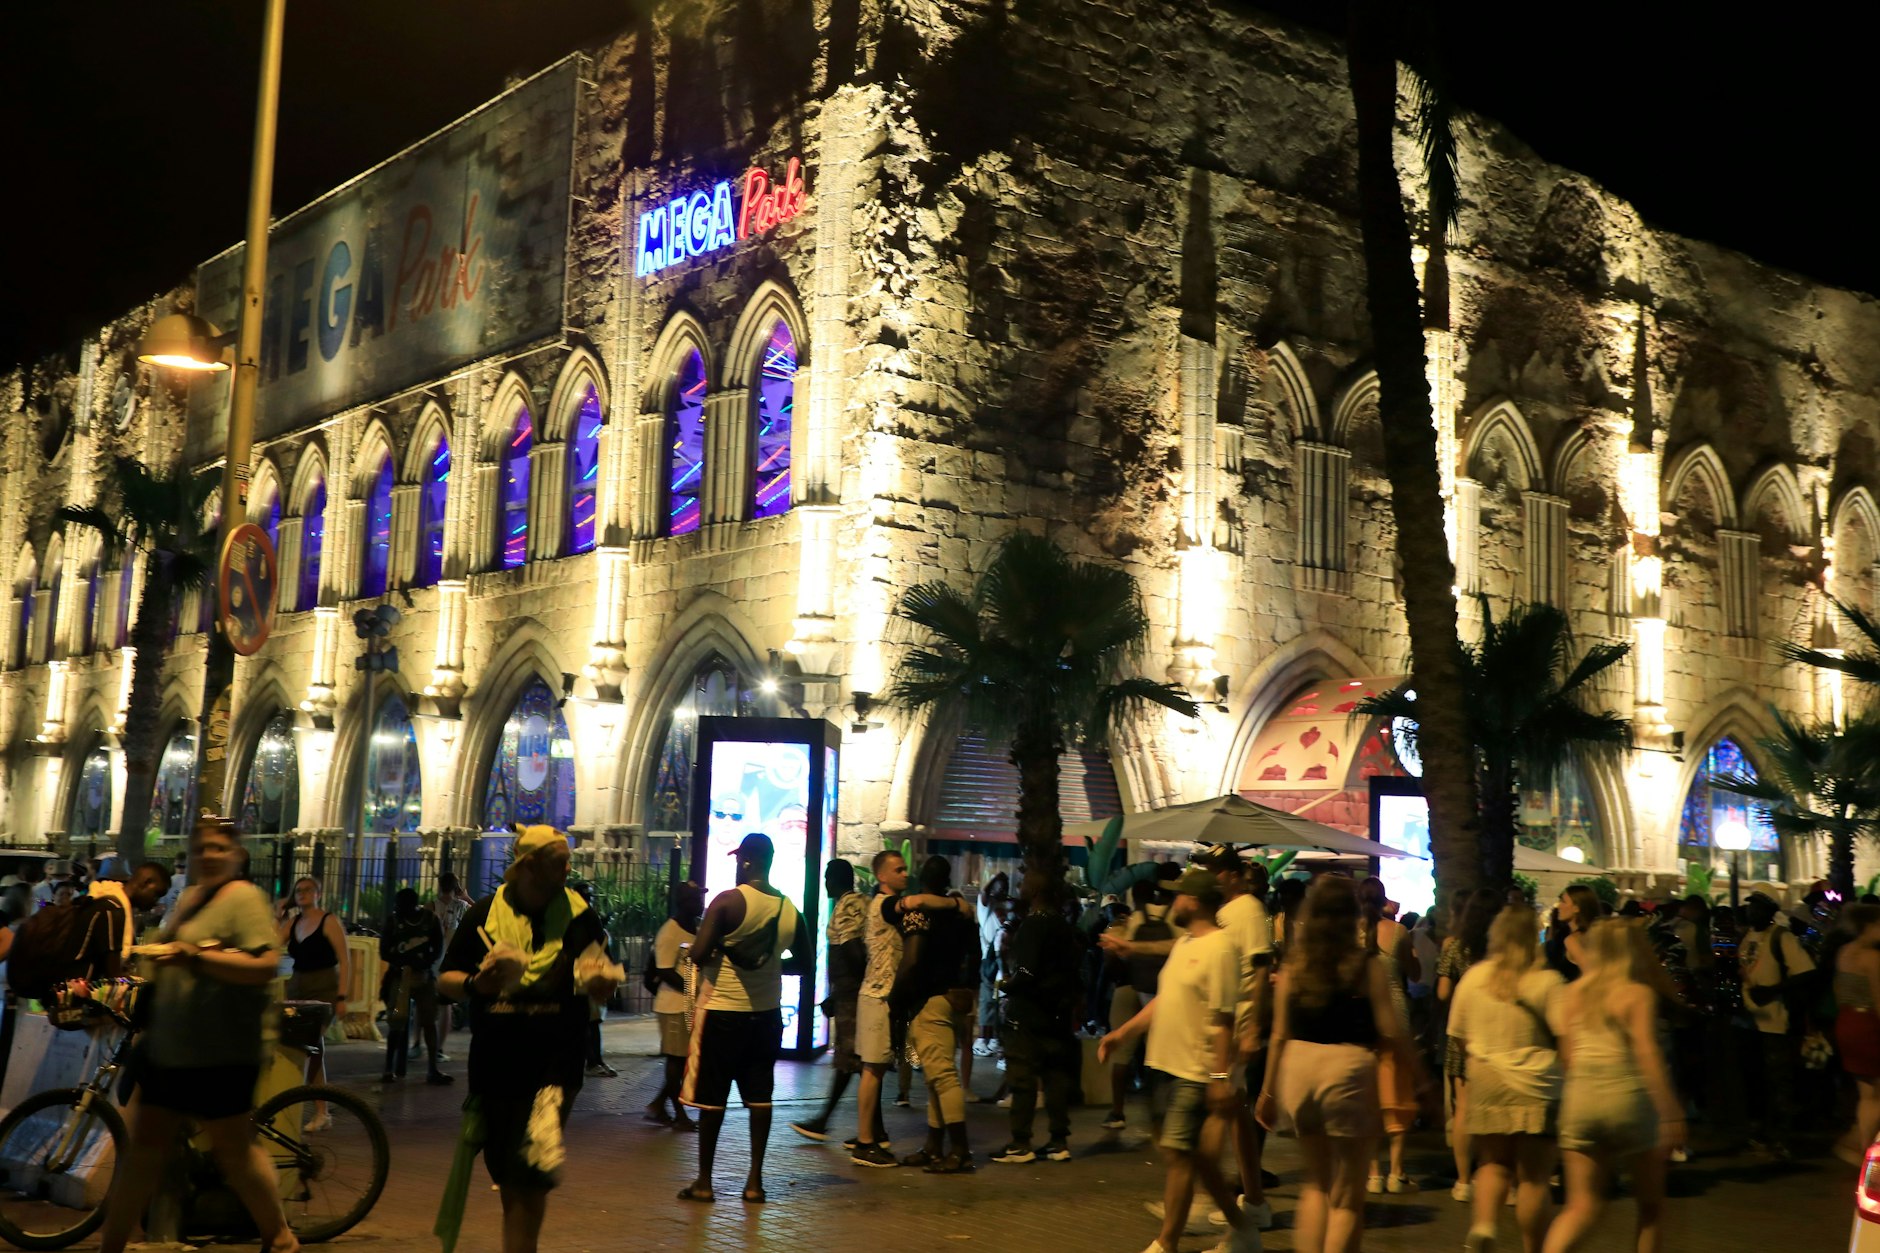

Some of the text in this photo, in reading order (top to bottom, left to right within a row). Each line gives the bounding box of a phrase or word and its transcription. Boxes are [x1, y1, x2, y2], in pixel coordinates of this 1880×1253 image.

[388, 193, 484, 332] Park
[636, 156, 808, 279] MEGA Park
